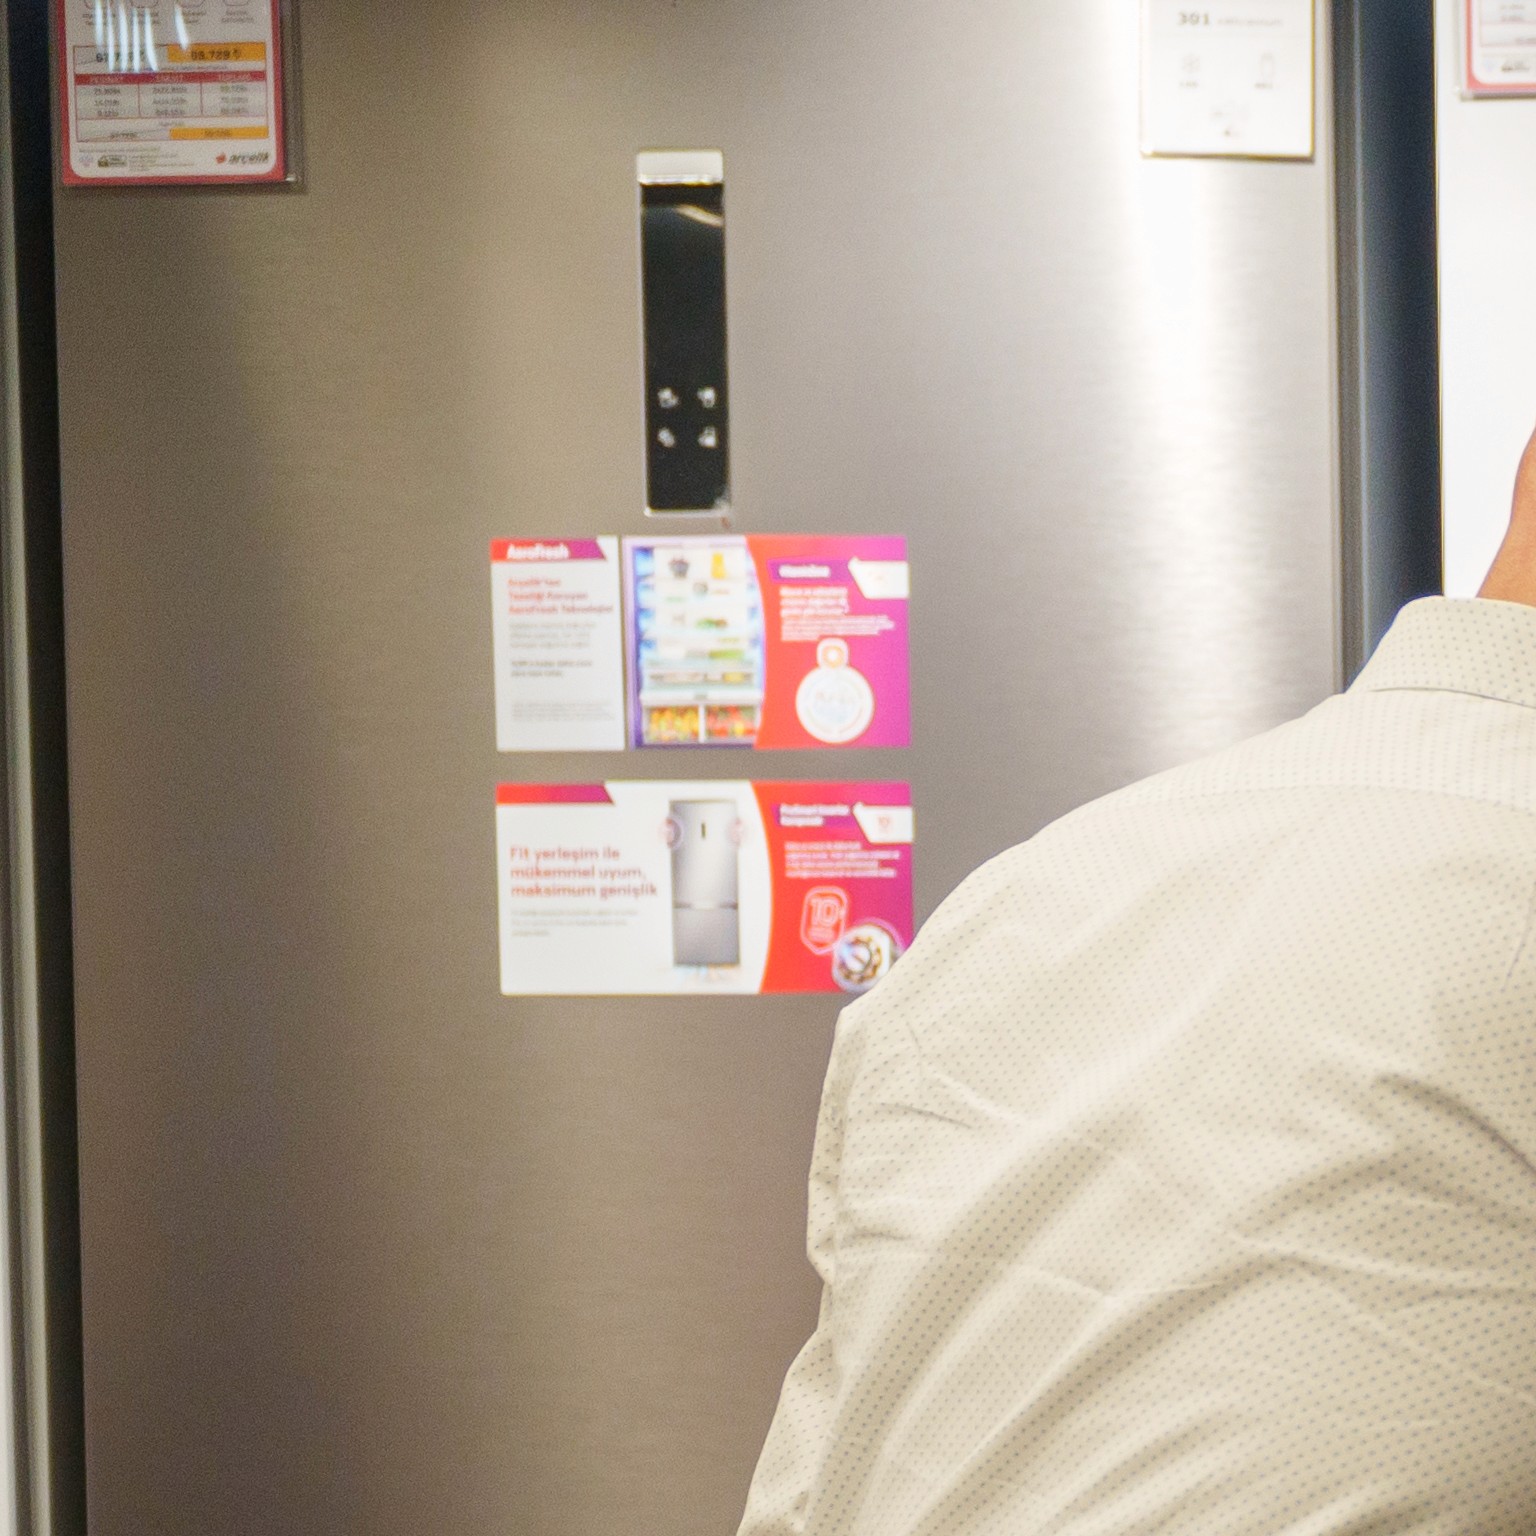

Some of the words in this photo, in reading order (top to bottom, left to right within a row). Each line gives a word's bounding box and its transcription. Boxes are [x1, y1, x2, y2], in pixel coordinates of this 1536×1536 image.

[510, 847, 529, 860] Fit
[534, 845, 599, 865] yerleşim
[603, 845, 620, 860] ile
[510, 864, 595, 879] mükemmel
[510, 883, 596, 897] maksimum
[600, 883, 658, 900] genişlik
